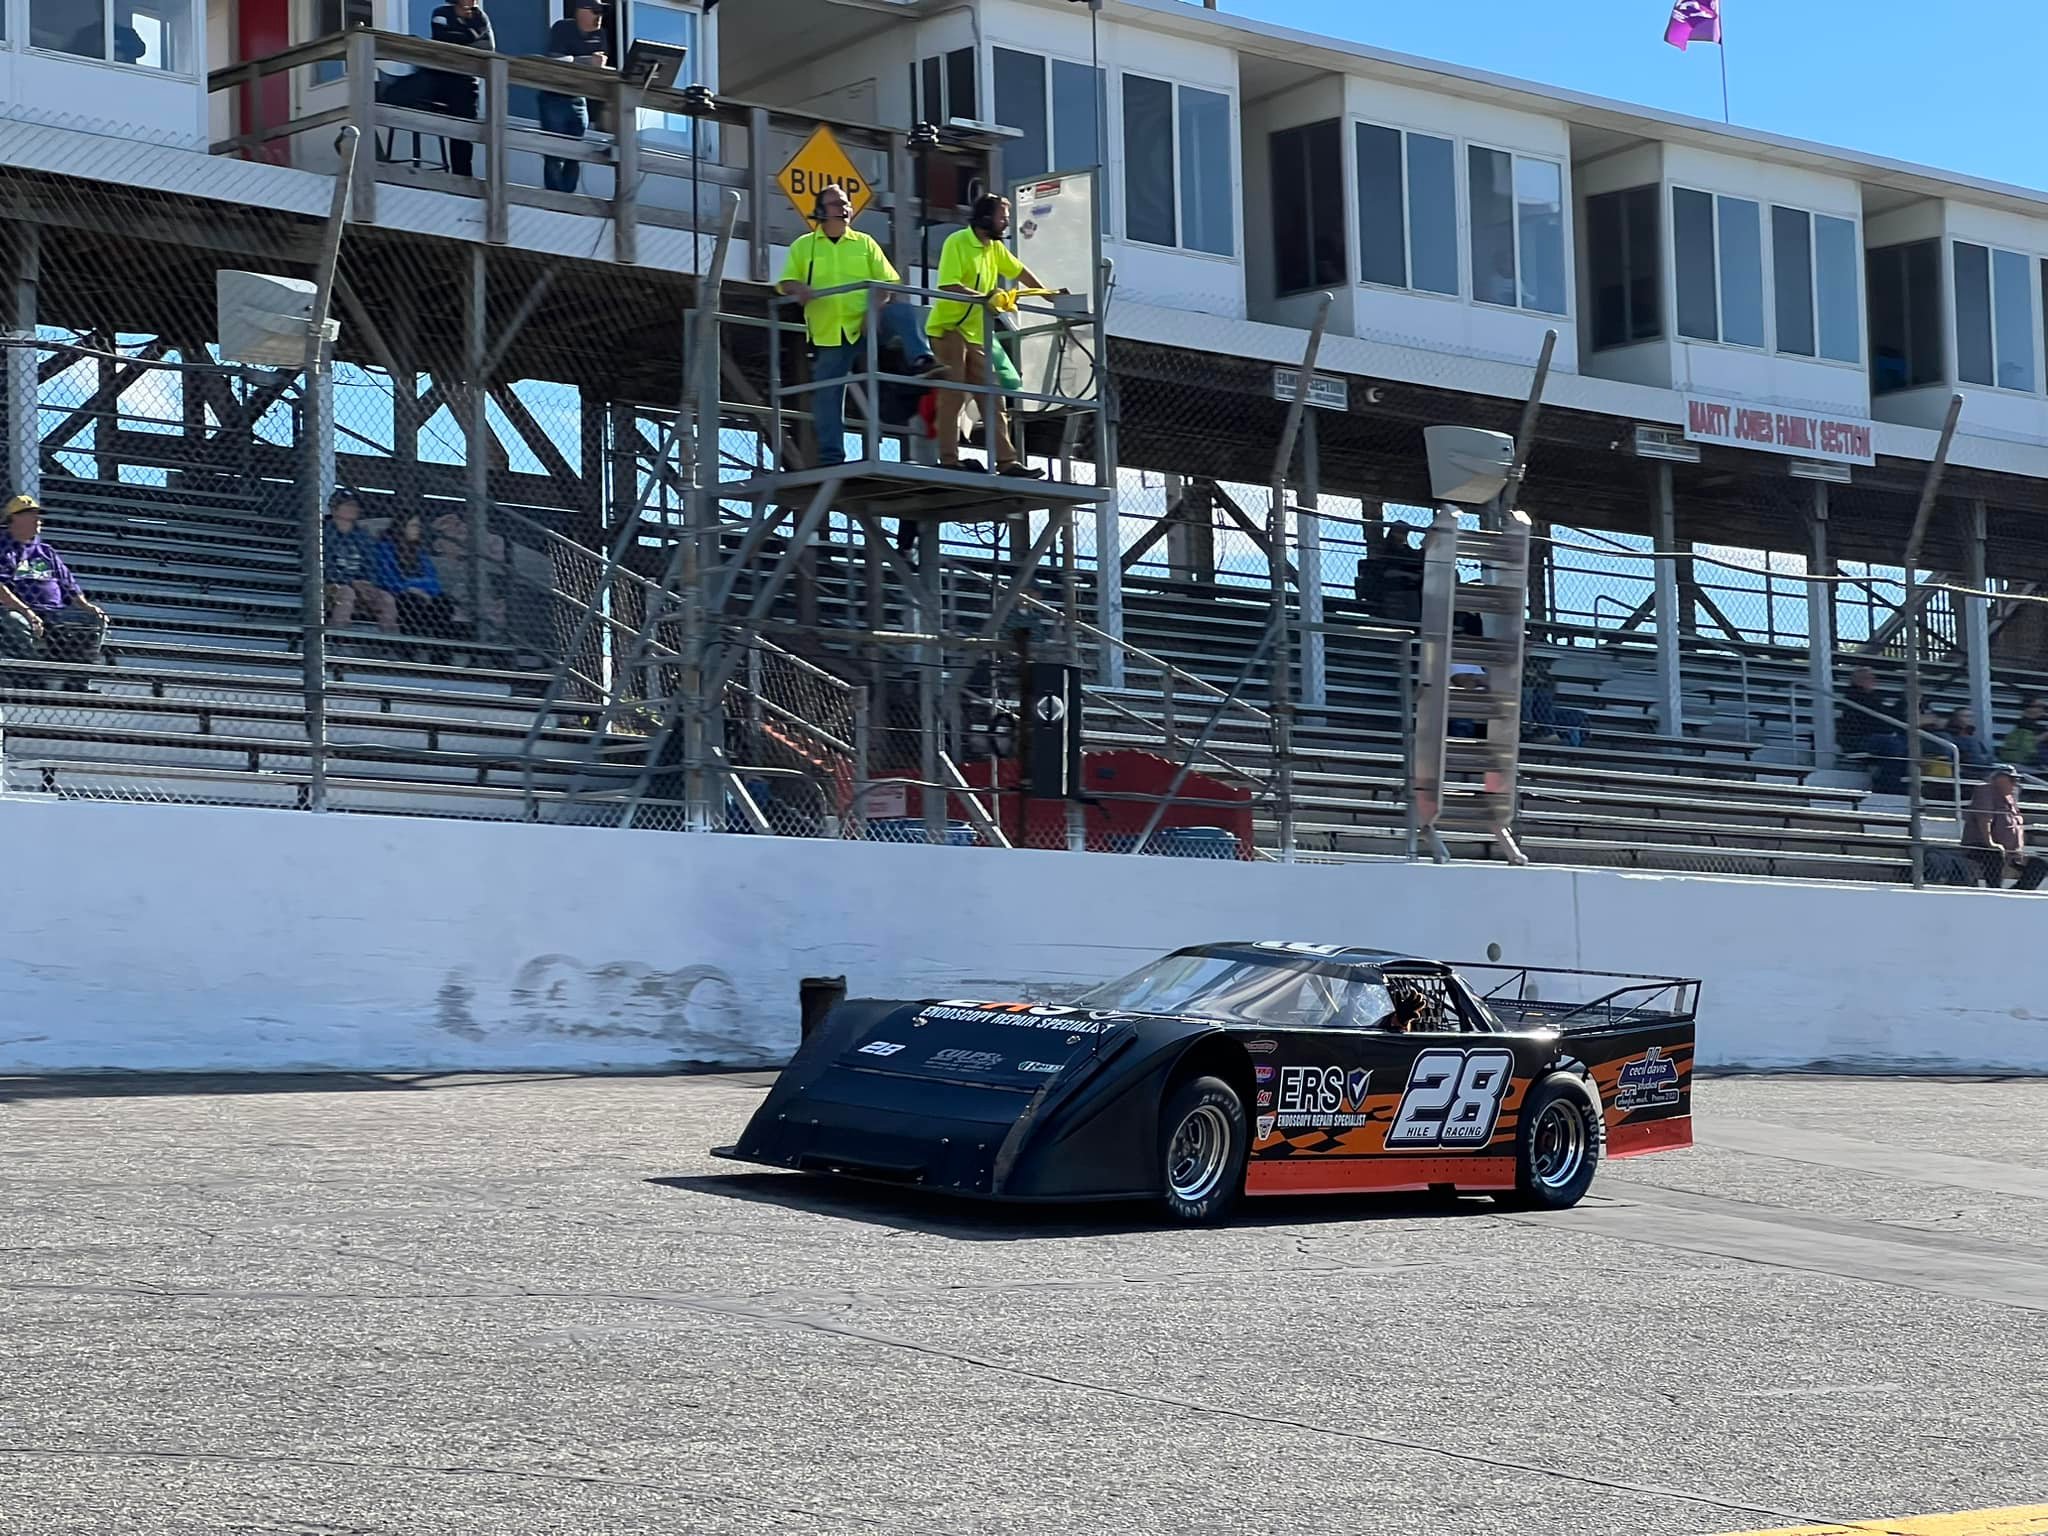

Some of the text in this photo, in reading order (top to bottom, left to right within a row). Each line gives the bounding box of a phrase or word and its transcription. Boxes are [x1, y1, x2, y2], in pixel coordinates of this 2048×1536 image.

[1688, 400, 1731, 437] MARTY
[1734, 408, 1773, 444] JONES
[1776, 414, 1817, 450] FAMILY
[1820, 420, 1871, 458] SECTION
[919, 1005, 1115, 1035] ENDOSCOPY REPAIR SPECIALIST
[858, 1040, 906, 1057] 28
[1647, 1062, 1668, 1075] davis
[1278, 1066, 1344, 1113] ERS
[1385, 1049, 1513, 1148] 28
[1277, 1114, 1366, 1127] ENDOSCOPY REPAIR SPECIALIST
[1406, 1126, 1482, 1137] HILE RACING
